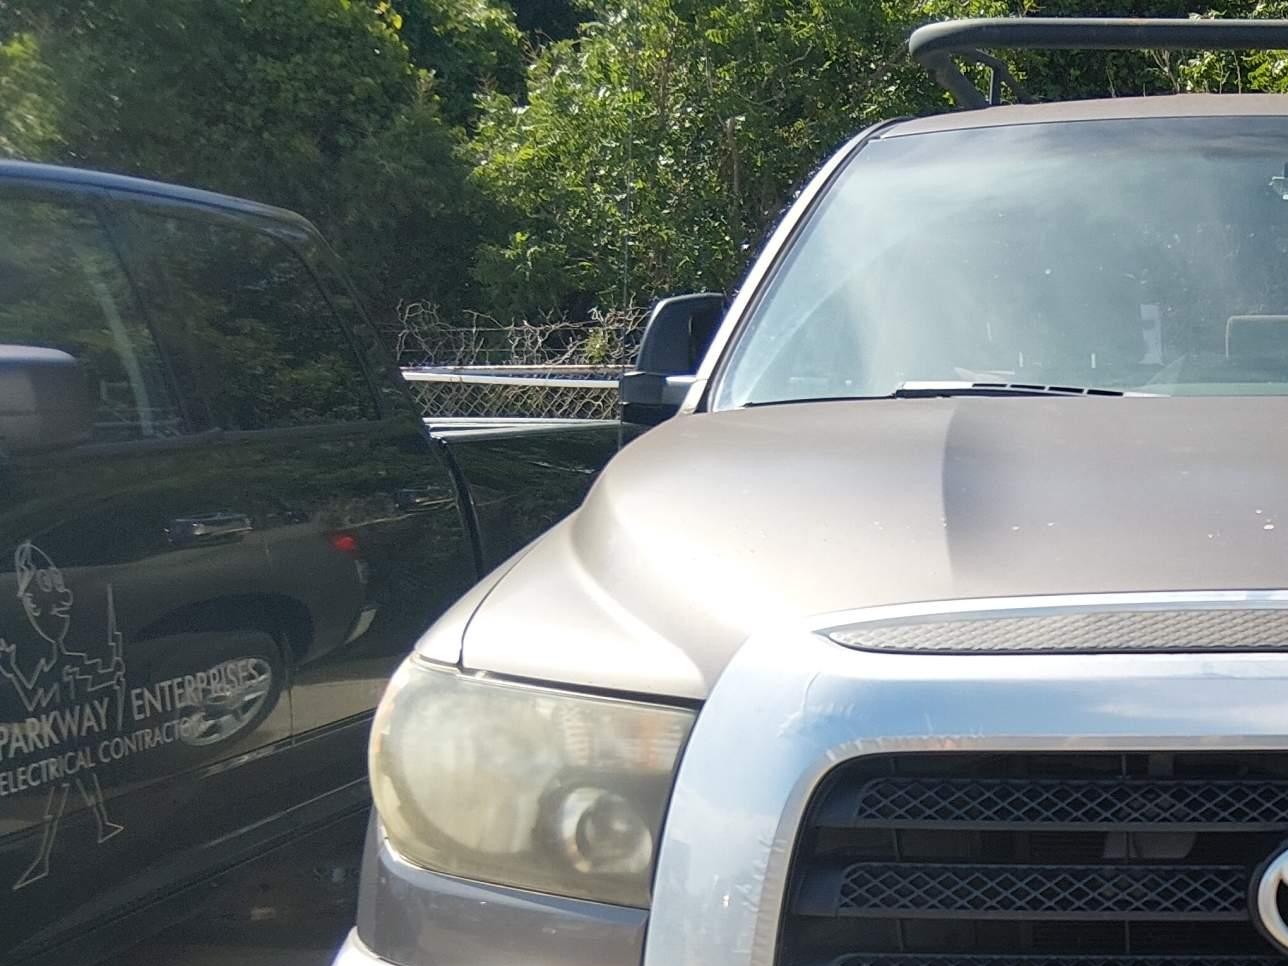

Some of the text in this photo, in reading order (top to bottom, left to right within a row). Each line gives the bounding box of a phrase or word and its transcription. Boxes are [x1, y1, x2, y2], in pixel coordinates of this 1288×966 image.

[0, 658, 260, 761] PARKWAY ENTERPRISES
[0, 747, 97, 796] ELECTRICAL
